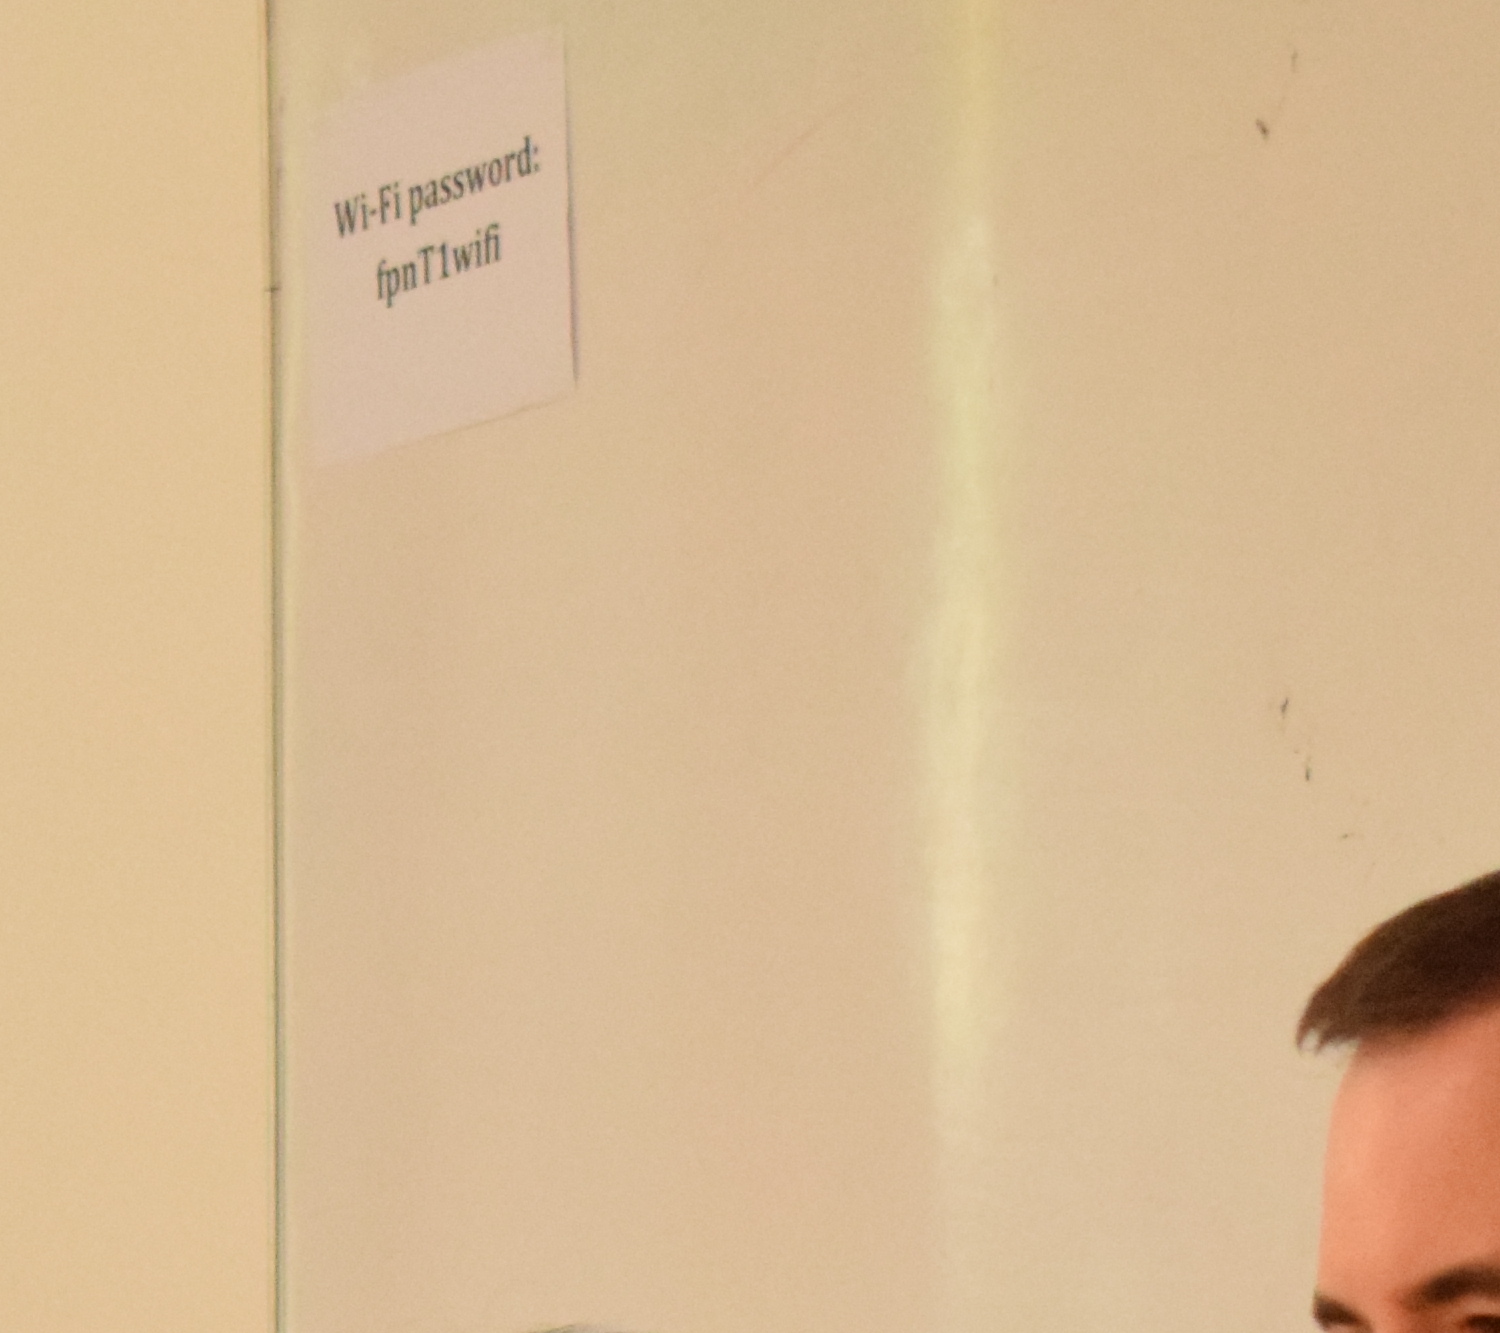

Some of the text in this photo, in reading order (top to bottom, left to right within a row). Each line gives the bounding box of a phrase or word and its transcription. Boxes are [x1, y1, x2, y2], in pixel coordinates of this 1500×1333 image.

[333, 135, 541, 238] Wi-Fi password:
[376, 223, 501, 308] fpnT1wifi
